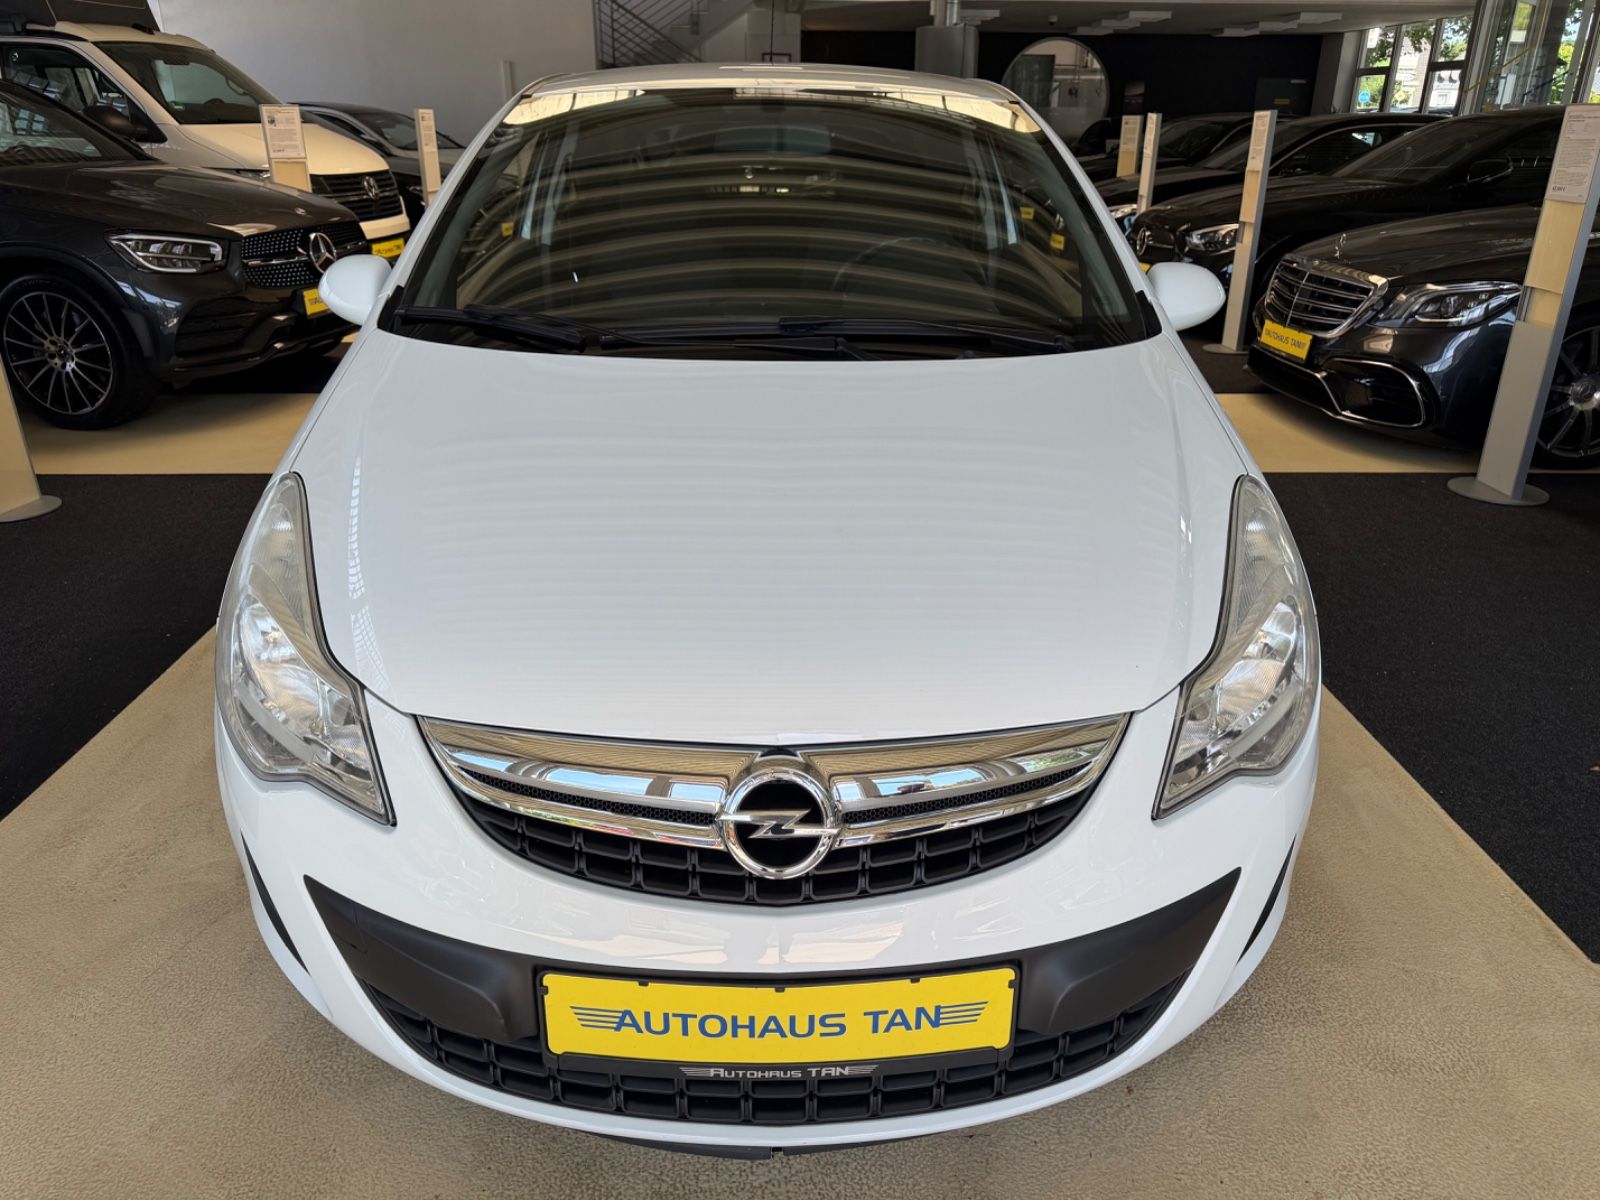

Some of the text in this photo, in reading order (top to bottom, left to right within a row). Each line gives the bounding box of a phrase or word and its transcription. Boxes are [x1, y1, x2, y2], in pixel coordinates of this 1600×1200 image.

[614, 1005, 941, 1039] AUTOHAUS TAN
[807, 1065, 850, 1078] TAN
